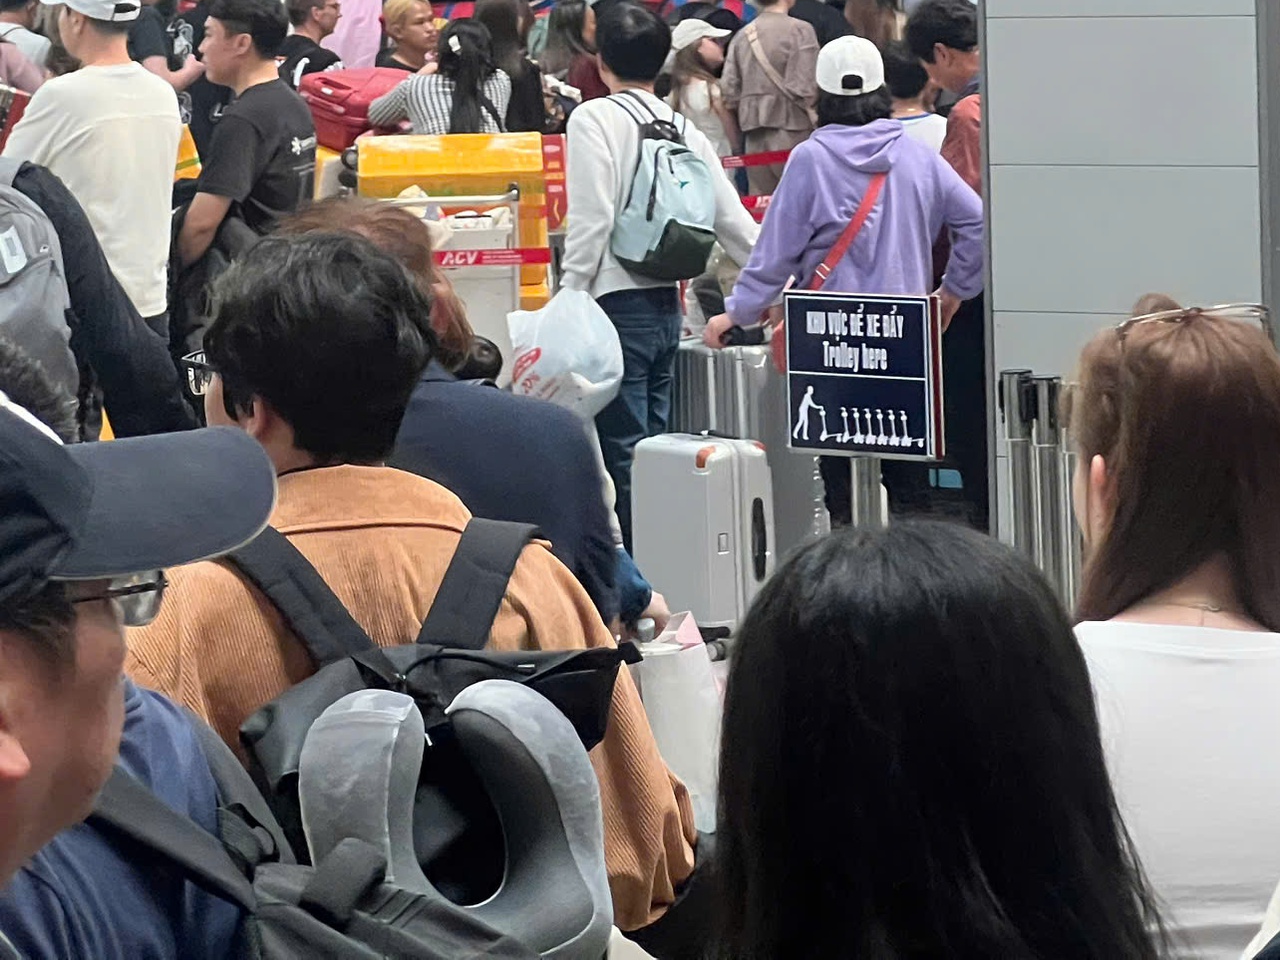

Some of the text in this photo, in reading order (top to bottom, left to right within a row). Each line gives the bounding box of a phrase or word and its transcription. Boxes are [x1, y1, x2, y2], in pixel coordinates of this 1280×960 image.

[442, 251, 478, 266] ACV
[822, 341, 888, 373] Trolley here
